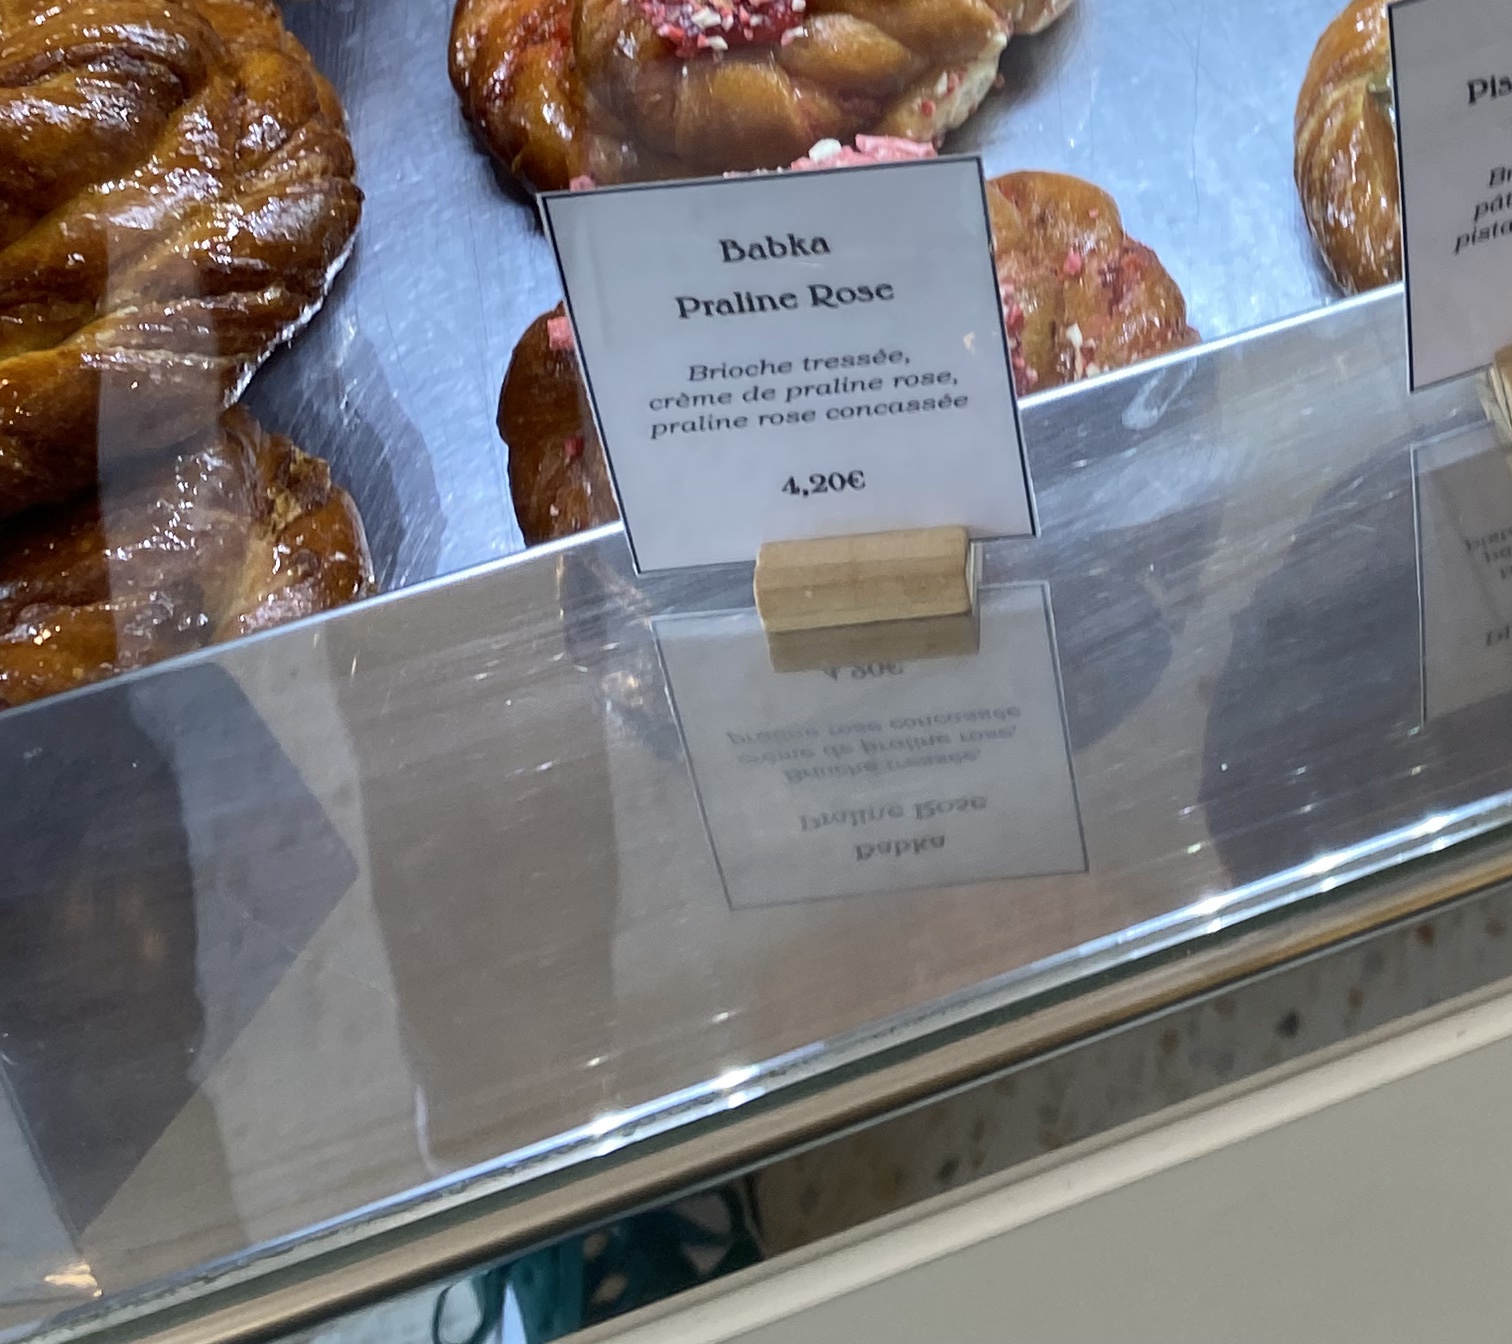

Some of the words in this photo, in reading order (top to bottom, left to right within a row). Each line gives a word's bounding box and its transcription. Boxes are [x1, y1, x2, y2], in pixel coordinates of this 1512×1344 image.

[719, 233, 830, 262] Babka
[675, 291, 797, 318] Praline
[807, 283, 893, 308] Rose
[688, 358, 792, 381] Brioche
[802, 348, 910, 371] tressée,
[648, 392, 732, 410] crème
[741, 384, 775, 402] de
[785, 376, 882, 403] praline
[892, 371, 957, 388] rose,
[650, 414, 748, 440] praline
[758, 409, 816, 426] rose
[825, 393, 968, 420] concassée
[782, 470, 865, 497] 4,20€
